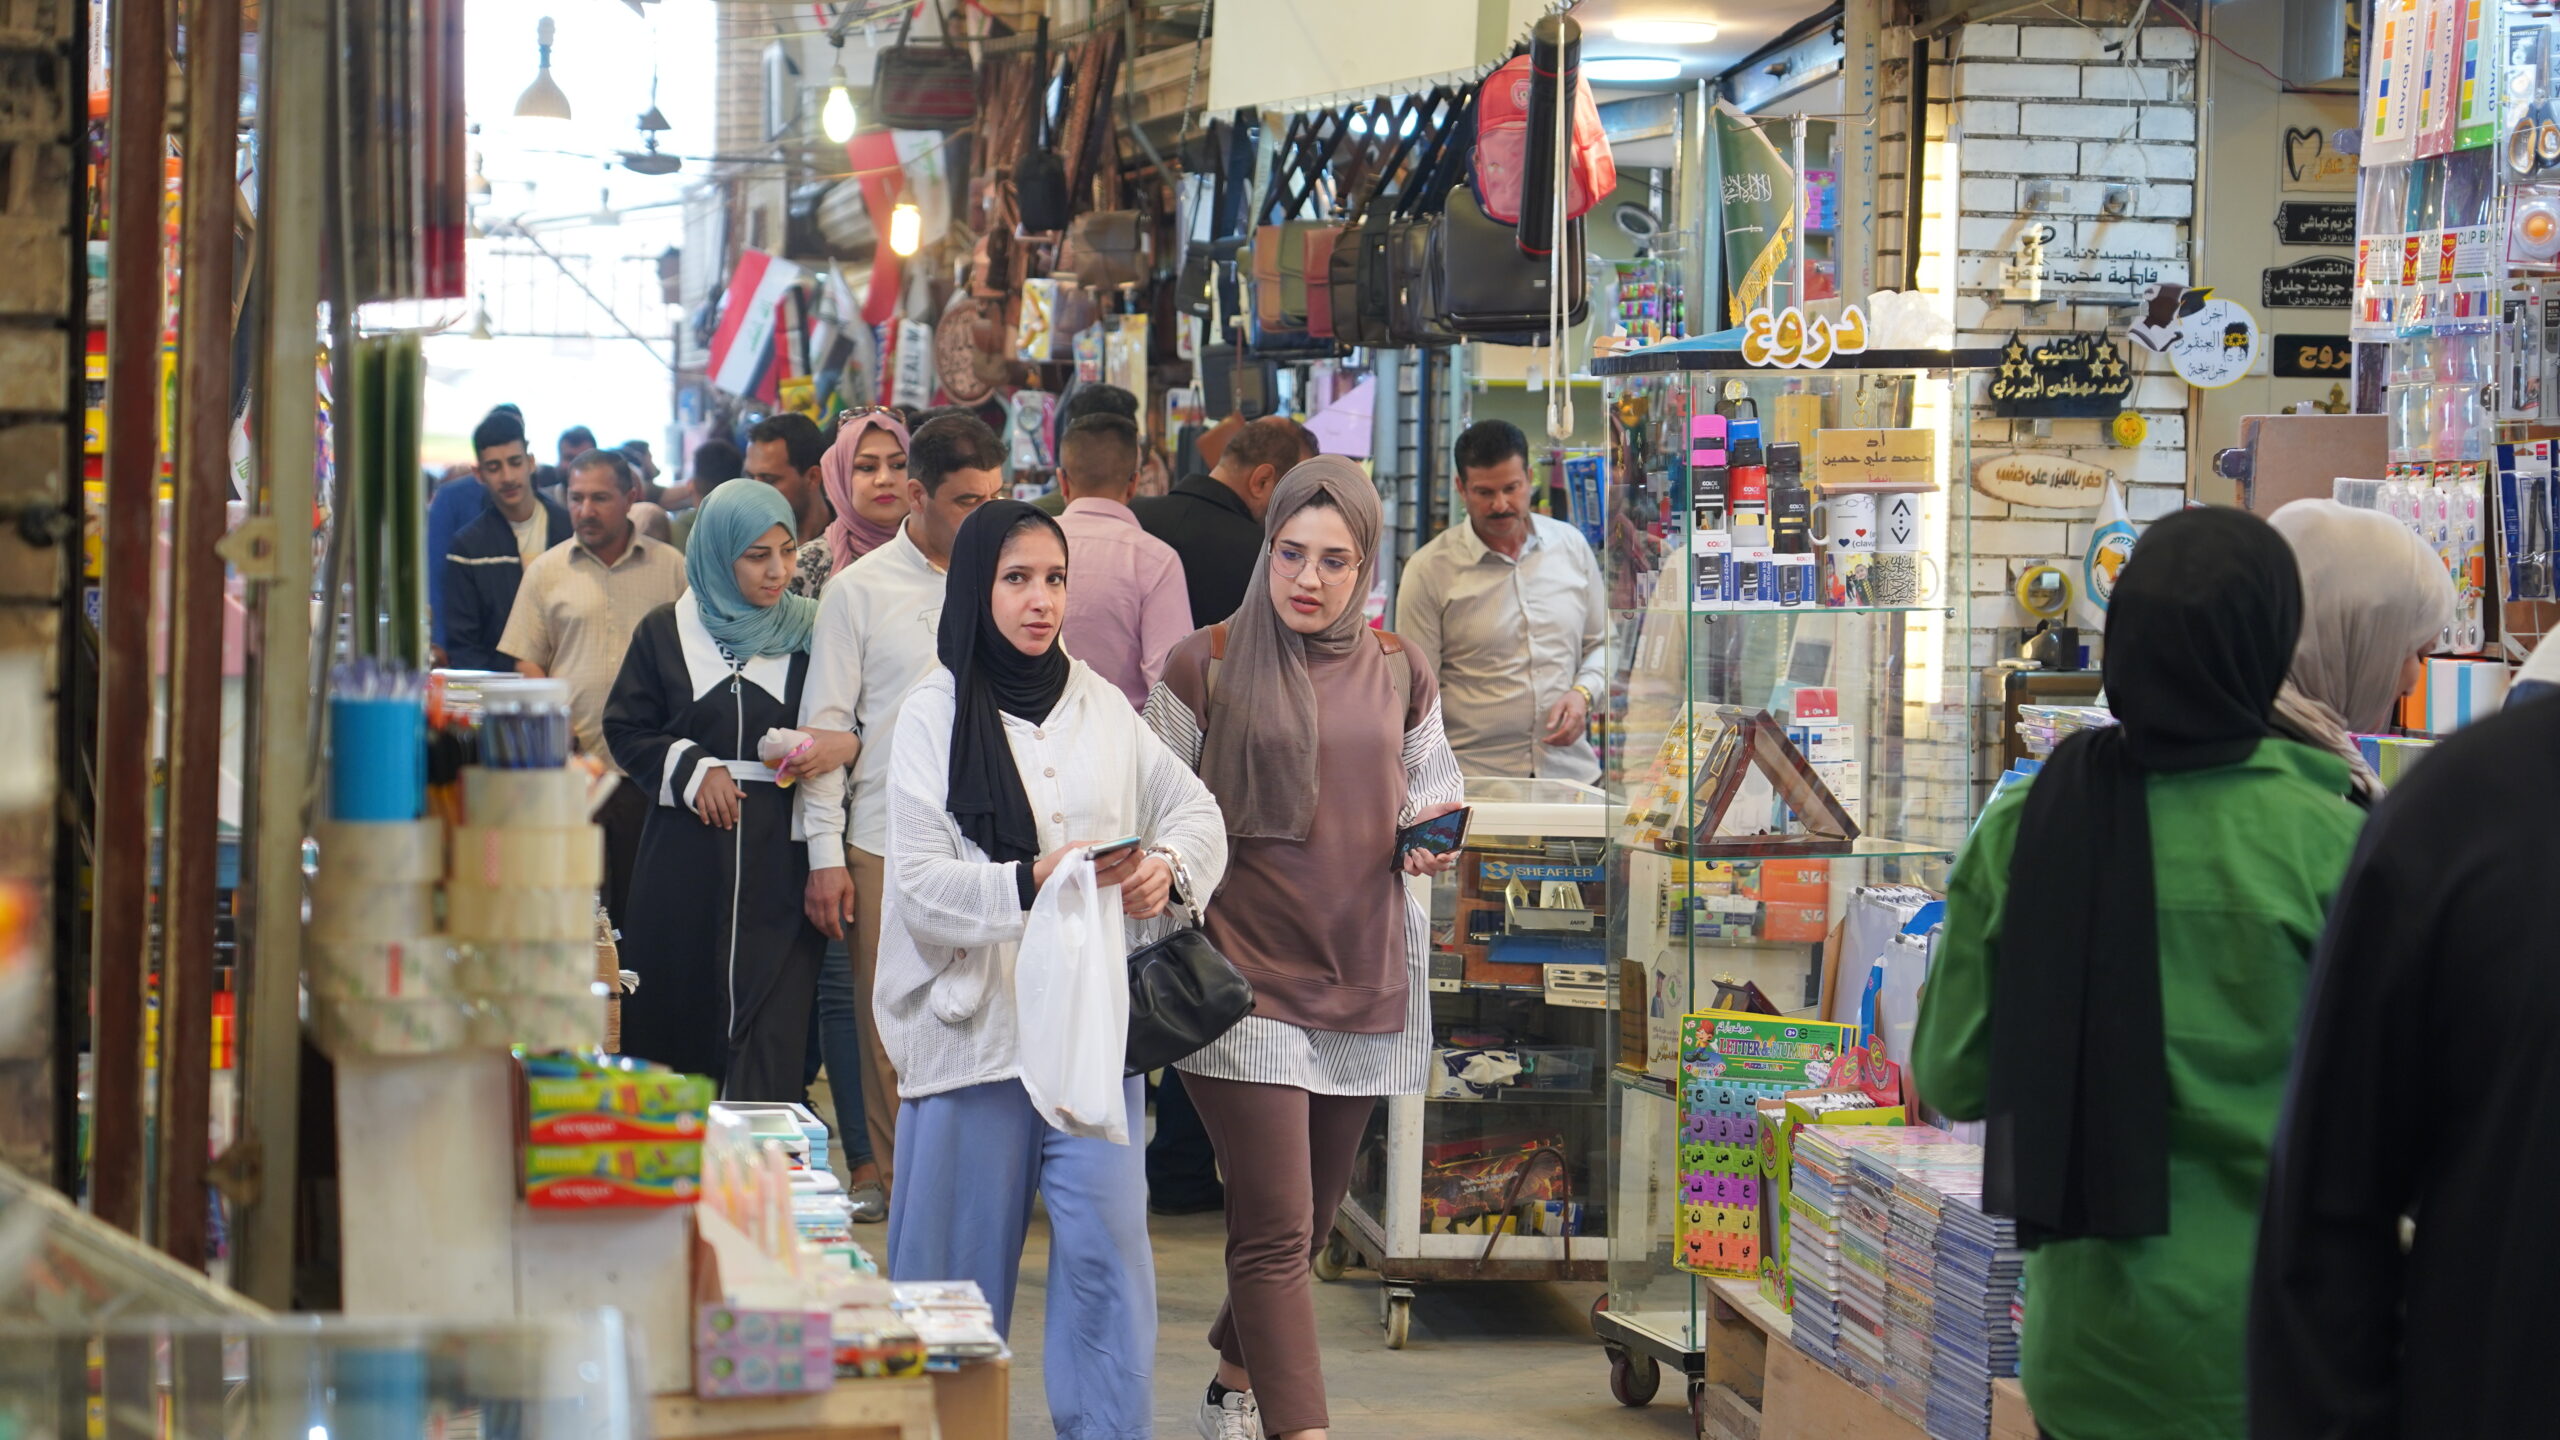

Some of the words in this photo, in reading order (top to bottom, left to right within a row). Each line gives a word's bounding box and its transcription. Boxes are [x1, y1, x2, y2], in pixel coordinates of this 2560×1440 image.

[2442, 4, 2453, 46] CLIP
[2406, 16, 2416, 57] CLIP
[2438, 52, 2450, 121] BOARD
[2397, 62, 2411, 130] BOARD
[2330, 216, 2354, 232] كريم
[2458, 231, 2477, 246] CLIP
[2307, 263, 2348, 279] النقيب
[2404, 260, 2417, 278] A4
[2440, 257, 2454, 275] A4
[2053, 268, 2102, 285] محمد
[2108, 265, 2158, 286] فاطمة
[2273, 279, 2305, 295] جليل
[2307, 279, 2345, 295] جودت
[1742, 308, 1867, 366] دروع
[2174, 330, 2220, 357] العنقود
[2036, 339, 2090, 366] النقيب
[2046, 373, 2098, 398] مصطفى
[1822, 454, 1861, 467] حسين
[1863, 450, 1888, 468] علي
[1890, 453, 1931, 464] محمد
[1995, 462, 2025, 486] خشب
[2025, 467, 2048, 487] على
[2049, 467, 2080, 490] بالليزر
[2080, 469, 2103, 489] حفر
[1514, 866, 1594, 878] SHEAFFER
[1718, 1039, 1760, 1055] LETTER
[1760, 1041, 1771, 1056] &
[1770, 1042, 1821, 1060] NUMBER
[1694, 1089, 1705, 1102] ج
[1719, 1091, 1731, 1105] ث
[1691, 1151, 1704, 1163] ض
[1715, 1152, 1730, 1164] ص
[1690, 1180, 1703, 1193] ف
[1716, 1179, 1726, 1197] غ
[1742, 1184, 1752, 1198] ع
[1691, 1210, 1702, 1223] ن
[1716, 1210, 1725, 1225] م
[1742, 1215, 1751, 1230] ل
[1690, 1239, 1702, 1251] ب
[1741, 1243, 1751, 1258] ي
